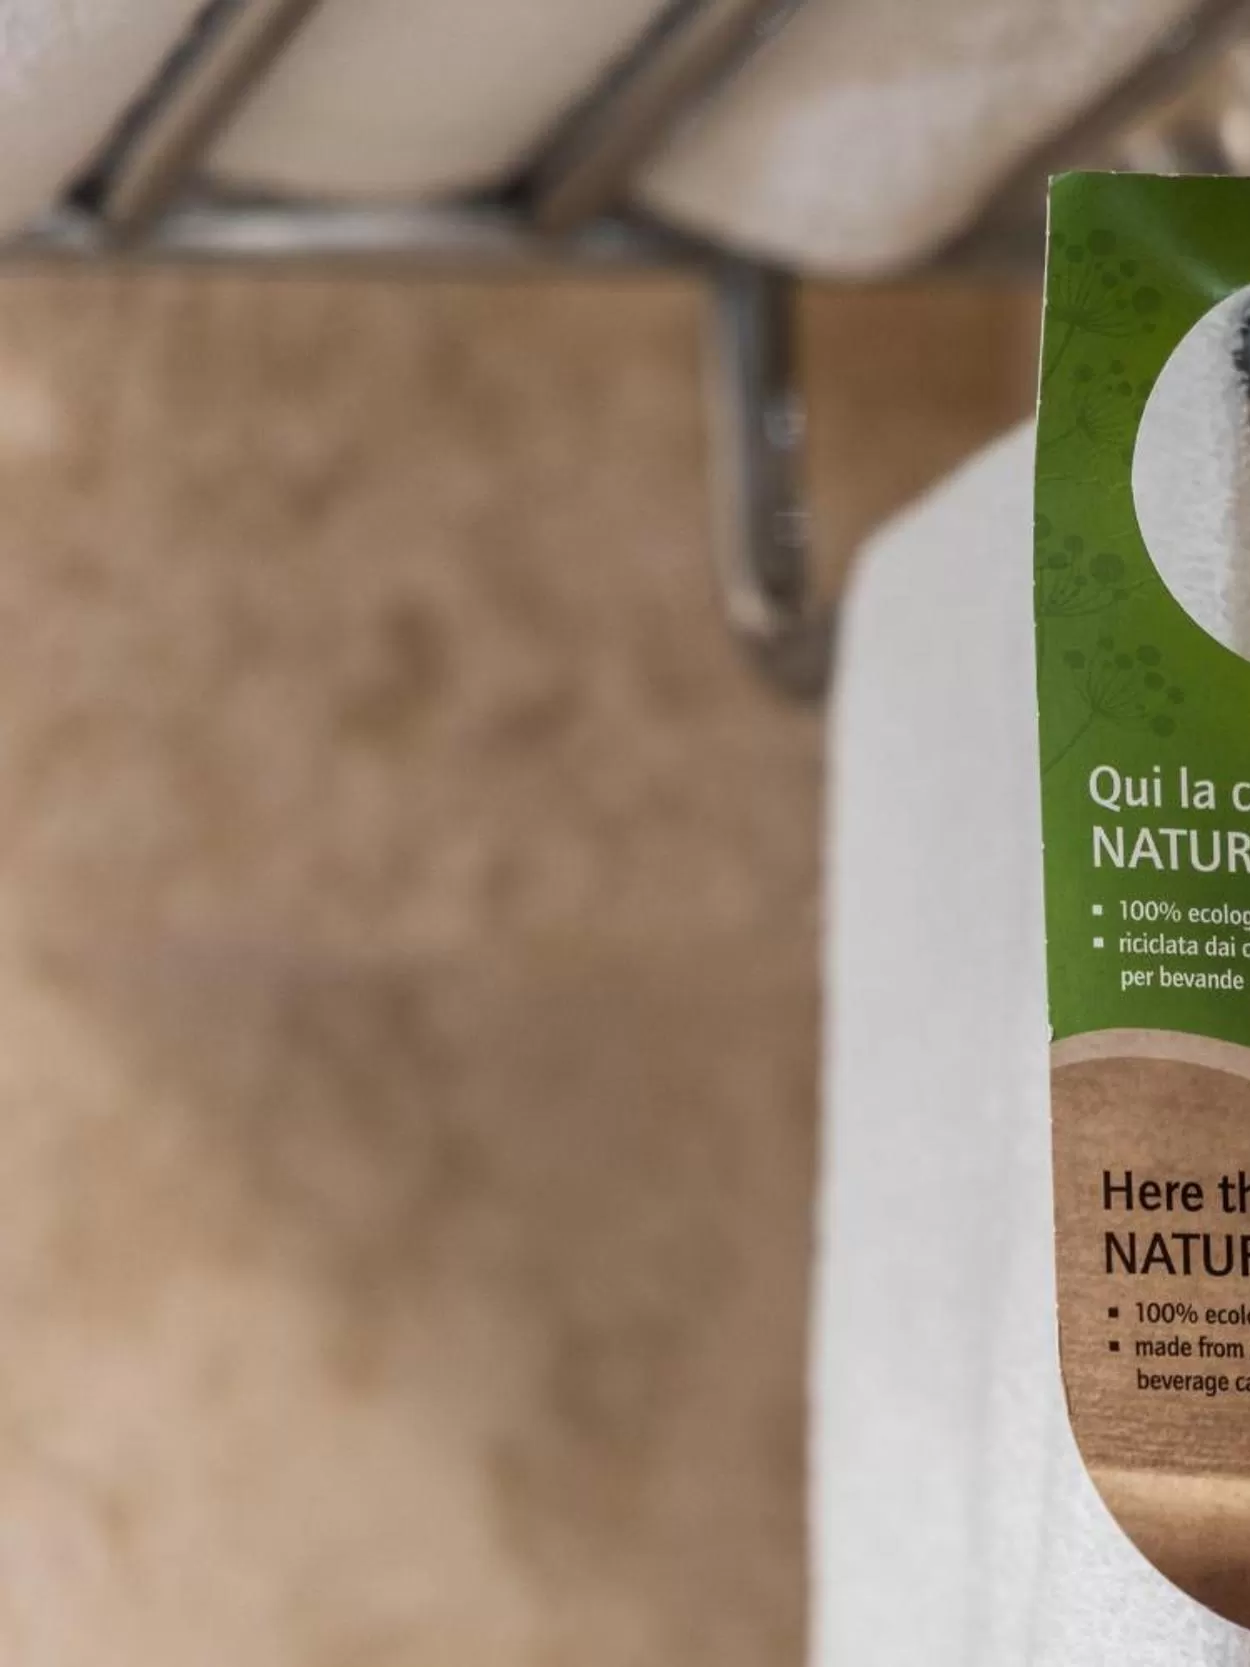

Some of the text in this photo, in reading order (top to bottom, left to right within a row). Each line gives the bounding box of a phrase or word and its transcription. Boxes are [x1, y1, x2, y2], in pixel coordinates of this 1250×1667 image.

[1089, 764, 1162, 813] Qui
[1180, 766, 1216, 810] la
[1120, 900, 1181, 922] 100%
[1120, 934, 1198, 955] riciclata
[1206, 936, 1235, 956] dai
[1121, 967, 1244, 991] per bevande
[1102, 1170, 1203, 1212] Here
[1136, 1302, 1198, 1324] 100%
[1136, 1337, 1192, 1358] made
[1199, 1336, 1244, 1359] from
[1137, 1369, 1229, 1396] beverage
